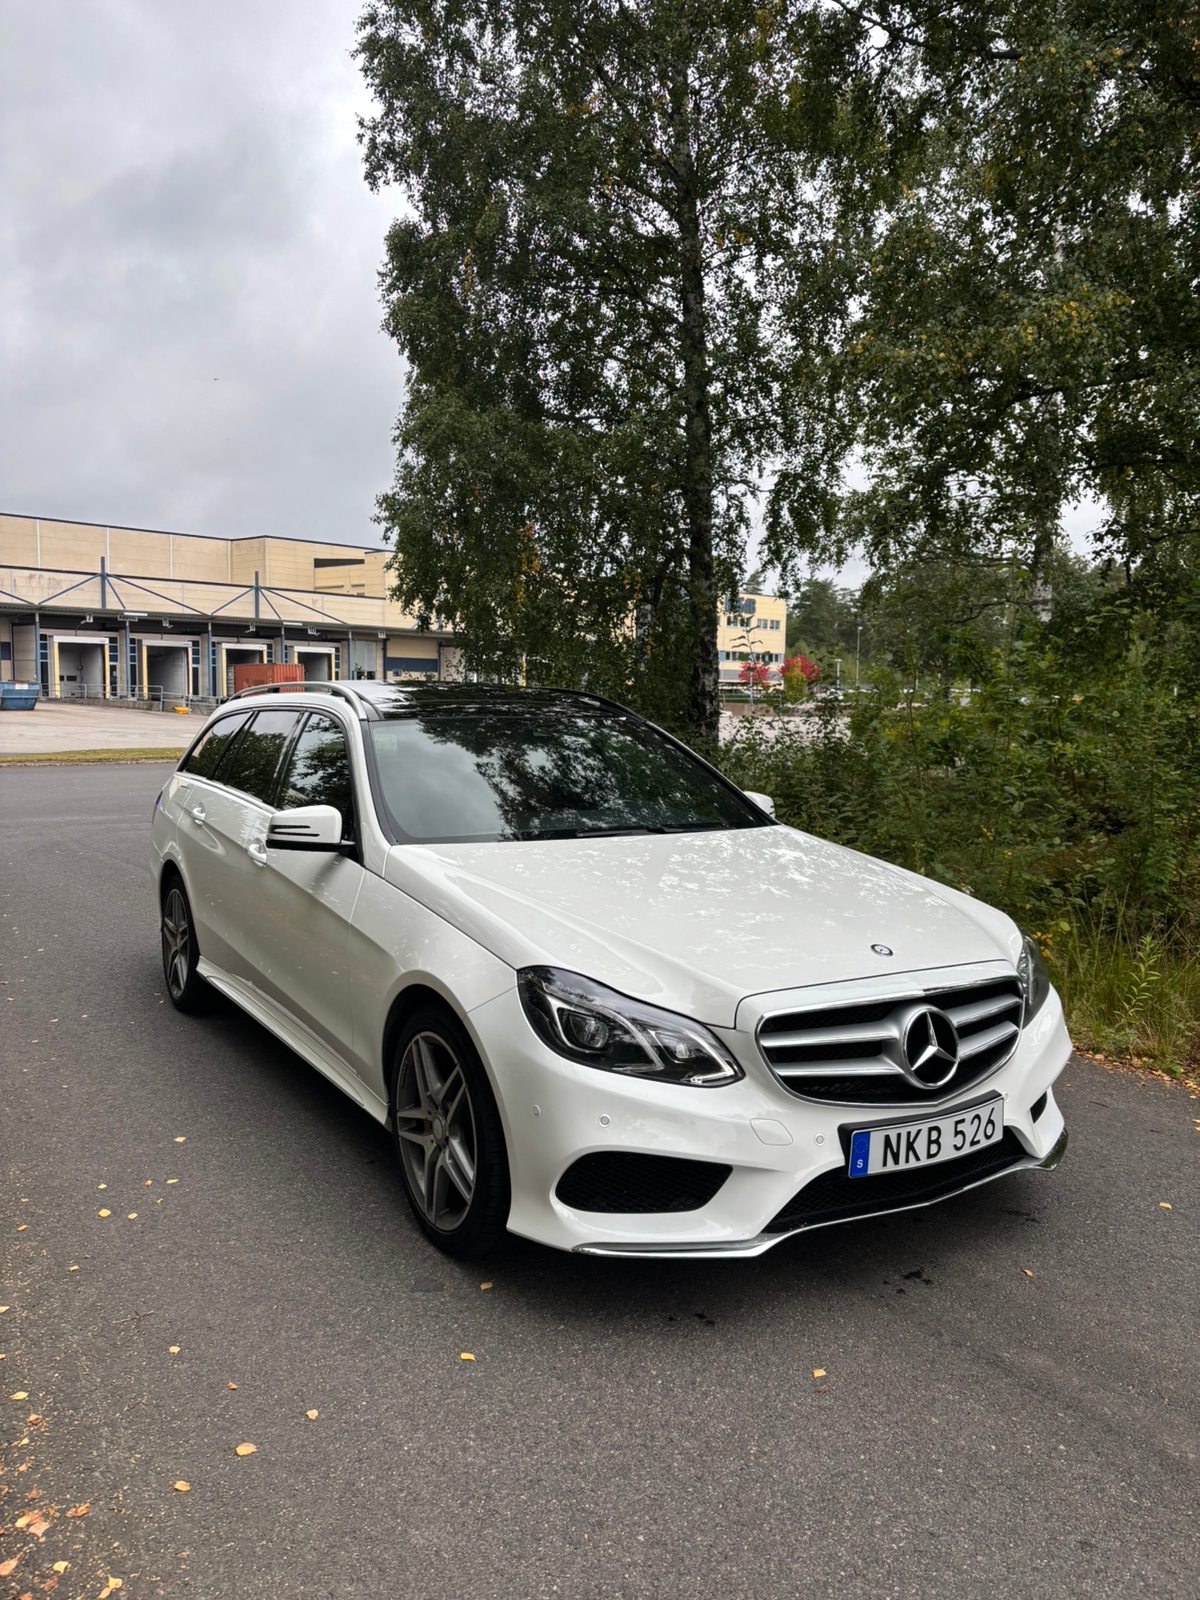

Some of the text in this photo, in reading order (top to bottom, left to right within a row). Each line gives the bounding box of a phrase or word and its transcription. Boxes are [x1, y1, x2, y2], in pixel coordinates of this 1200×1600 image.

[883, 1107, 996, 1167] NKB 526
[856, 1159, 863, 1168] S
